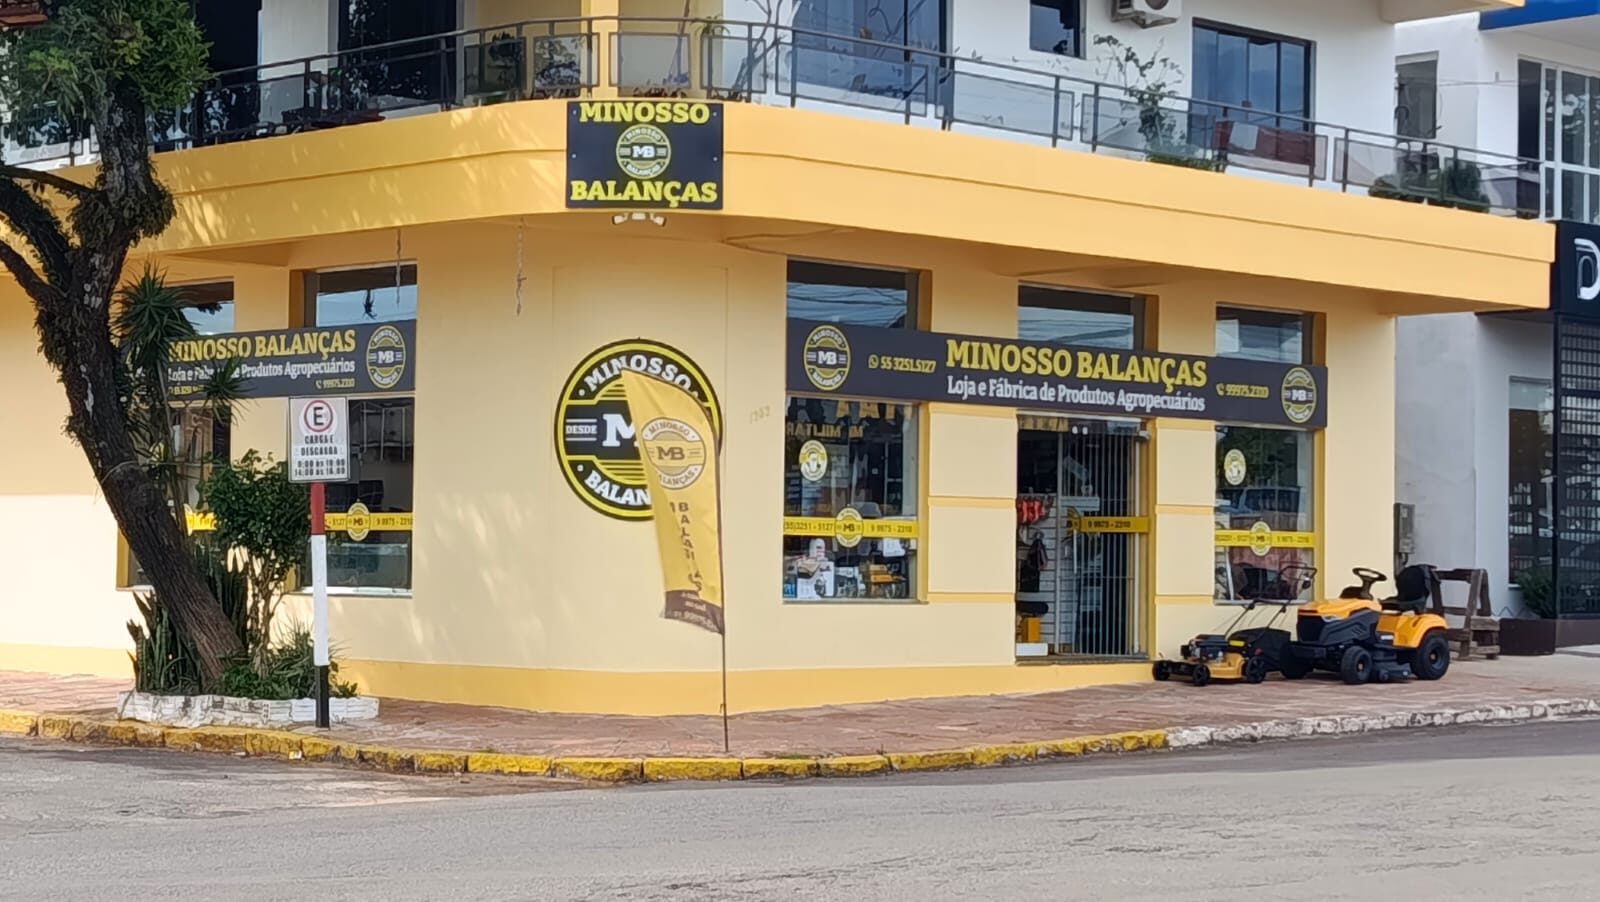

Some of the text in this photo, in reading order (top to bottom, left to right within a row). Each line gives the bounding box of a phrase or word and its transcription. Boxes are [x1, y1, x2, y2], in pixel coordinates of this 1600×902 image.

[579, 102, 710, 124] MINOSSO
[632, 145, 656, 158] MB
[570, 180, 718, 208] BALANÇAS
[168, 329, 356, 362] MINOSSO BALANÇAS
[378, 350, 395, 364] MB
[818, 350, 837, 365] MB
[187, 369, 193, 381] e
[241, 360, 283, 380] Produtos
[283, 356, 356, 380] Agropecuários
[584, 353, 693, 392] MINOSSO
[946, 339, 1208, 393] MINOSSO BALANÇAS
[947, 376, 1206, 413] Loja e Fábrica de Produtos Agropecuários
[1291, 389, 1307, 402] MB
[313, 406, 324, 426] E
[566, 425, 598, 434] DESDE
[648, 421, 690, 436] MINOSSO
[305, 434, 334, 445] CARGA E
[301, 445, 338, 457] DESCARGA
[656, 446, 685, 461] MB
